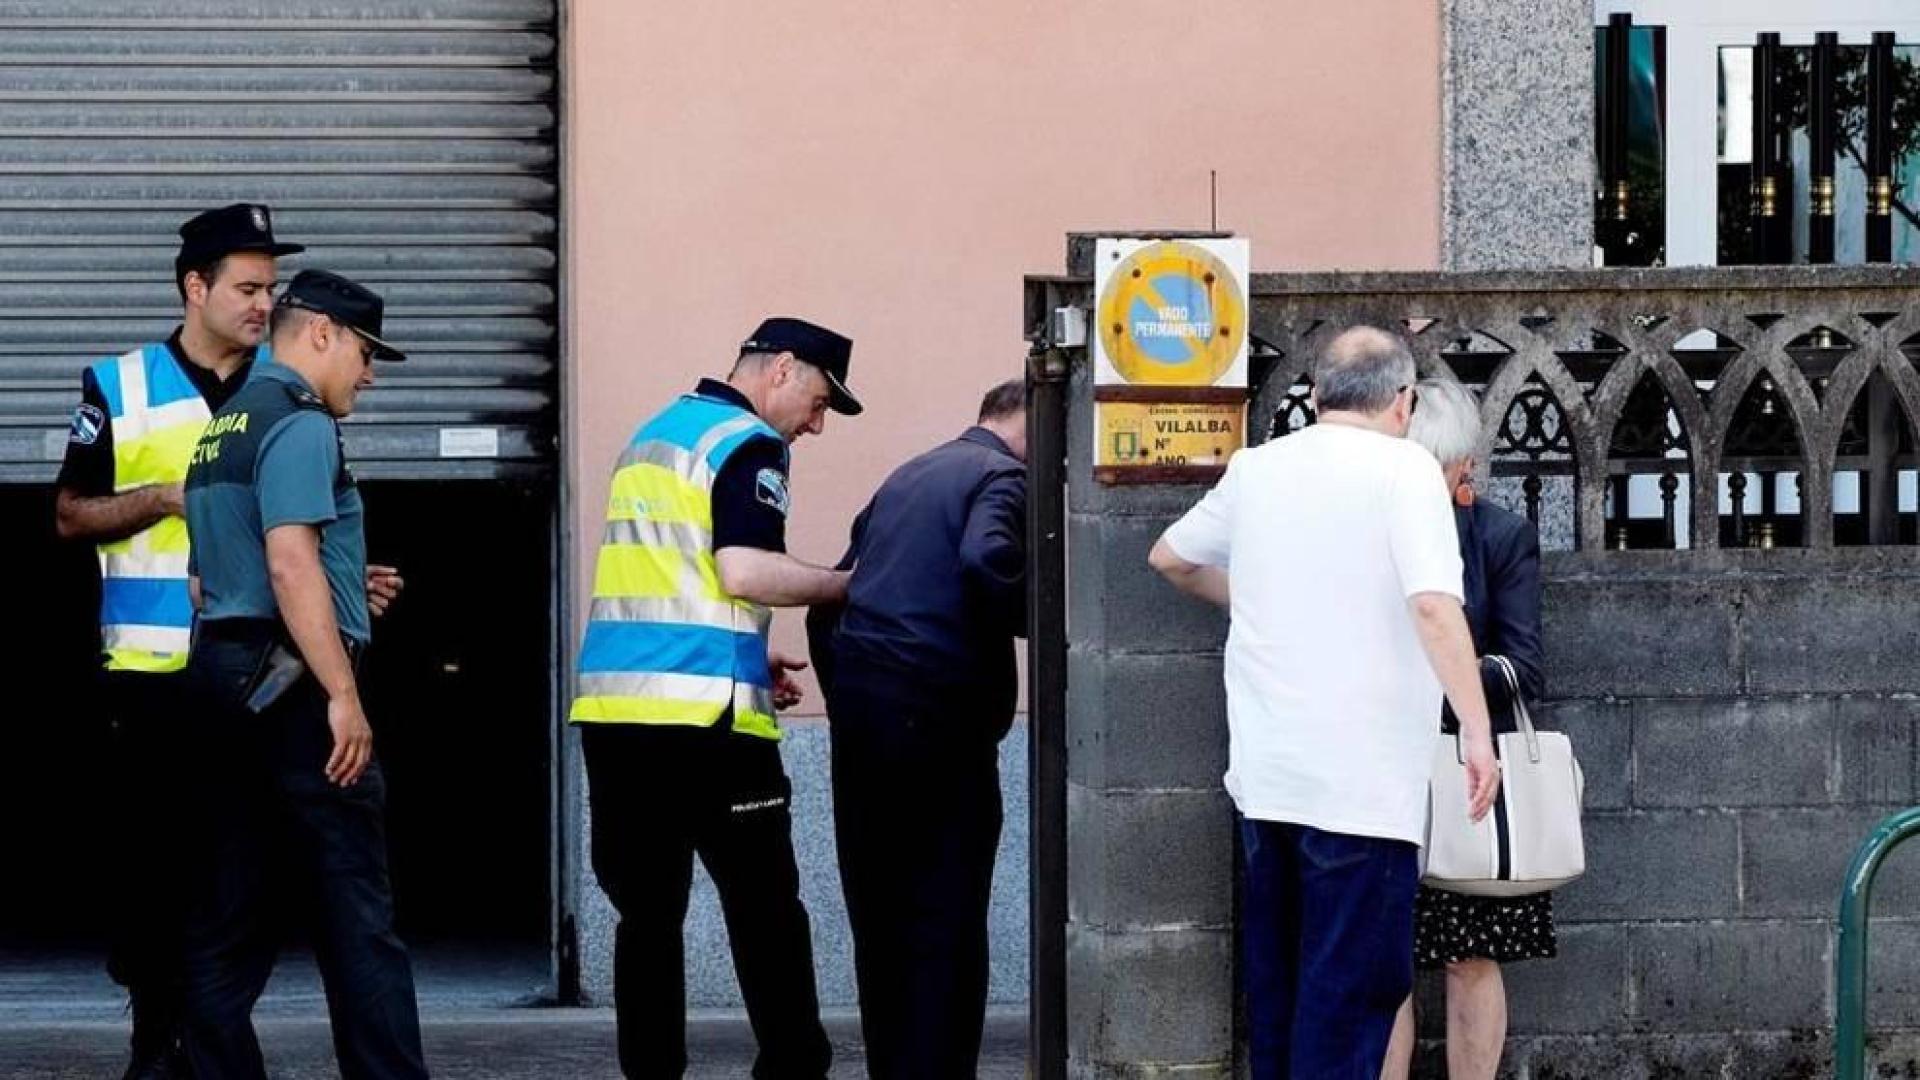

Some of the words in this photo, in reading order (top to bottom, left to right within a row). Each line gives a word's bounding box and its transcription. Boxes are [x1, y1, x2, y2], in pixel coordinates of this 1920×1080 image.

[1159, 305, 1189, 321] VADO
[1135, 320, 1212, 338] PERMANENTE
[1155, 420, 1232, 433] VILALBA
